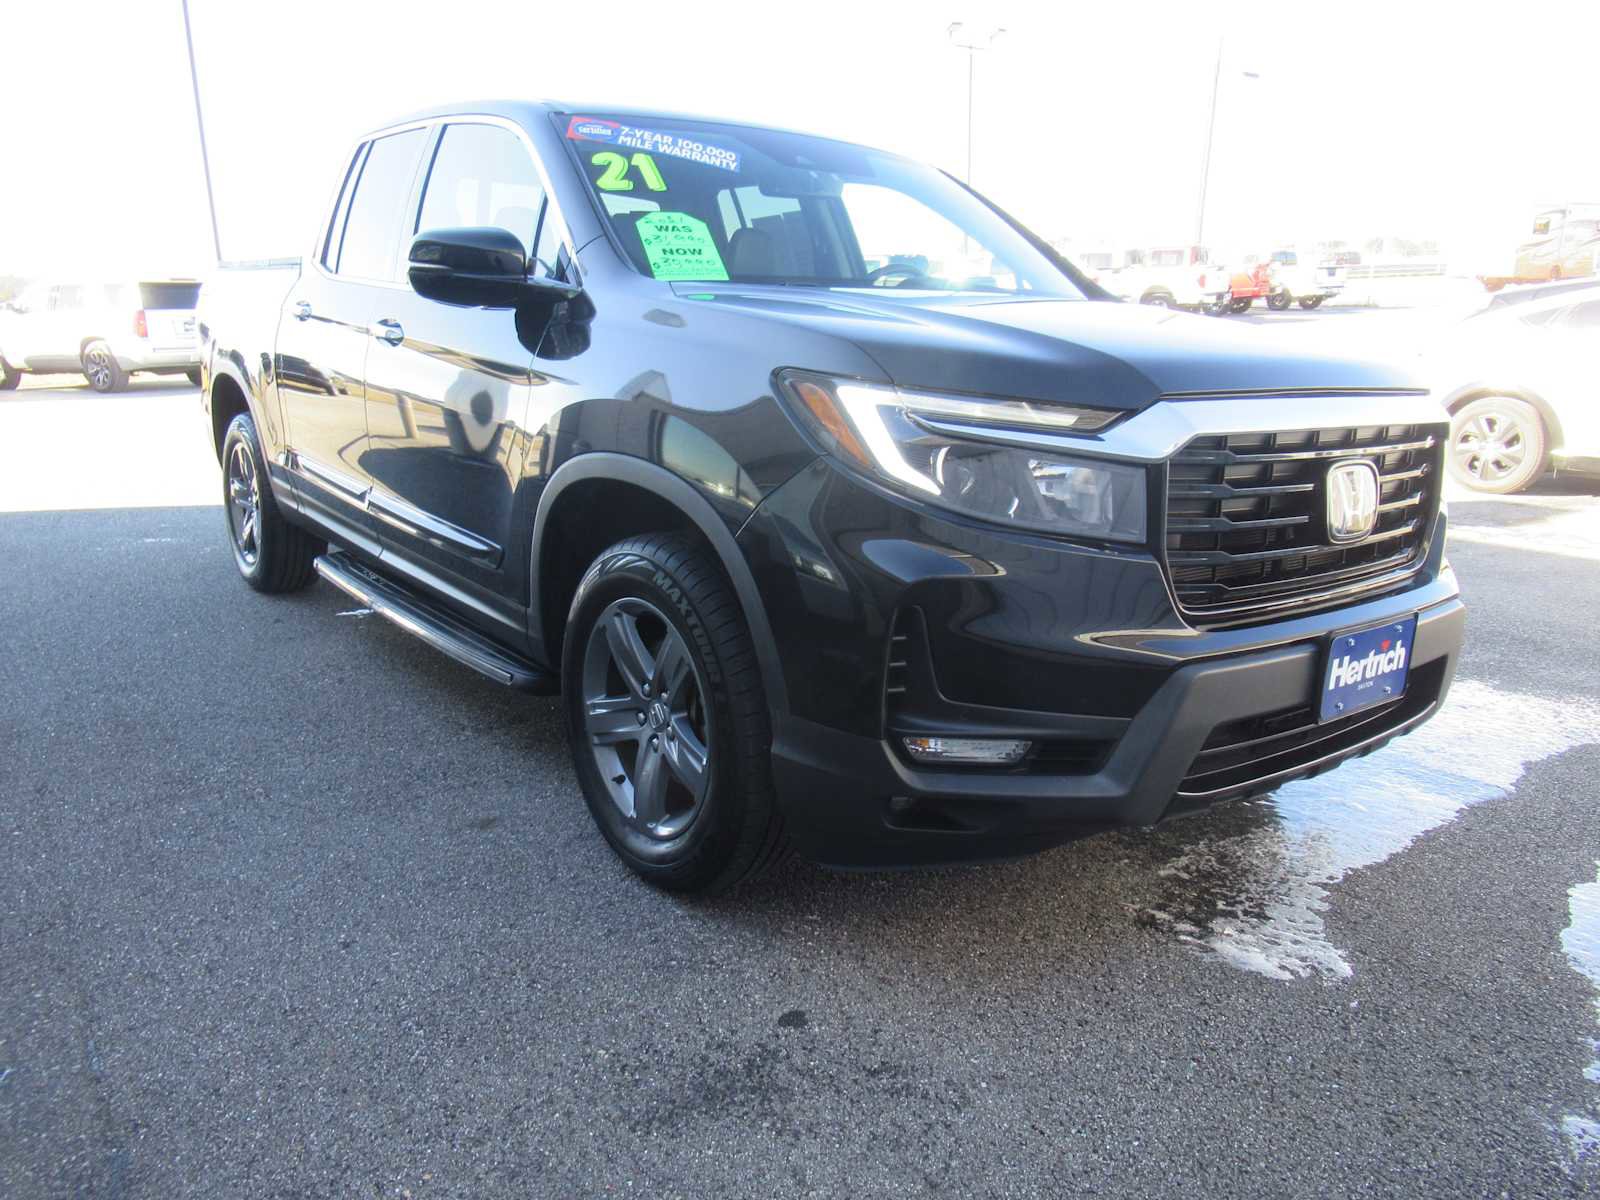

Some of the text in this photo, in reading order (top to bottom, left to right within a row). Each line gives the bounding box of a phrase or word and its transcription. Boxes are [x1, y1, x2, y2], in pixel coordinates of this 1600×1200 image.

[620, 126, 673, 145] 7-YEAR
[618, 135, 738, 171] MILE WARRANTY
[591, 152, 668, 192] 21
[654, 225, 693, 233] WAS
[661, 248, 703, 256] NOW
[1328, 639, 1406, 691] Hertrich
